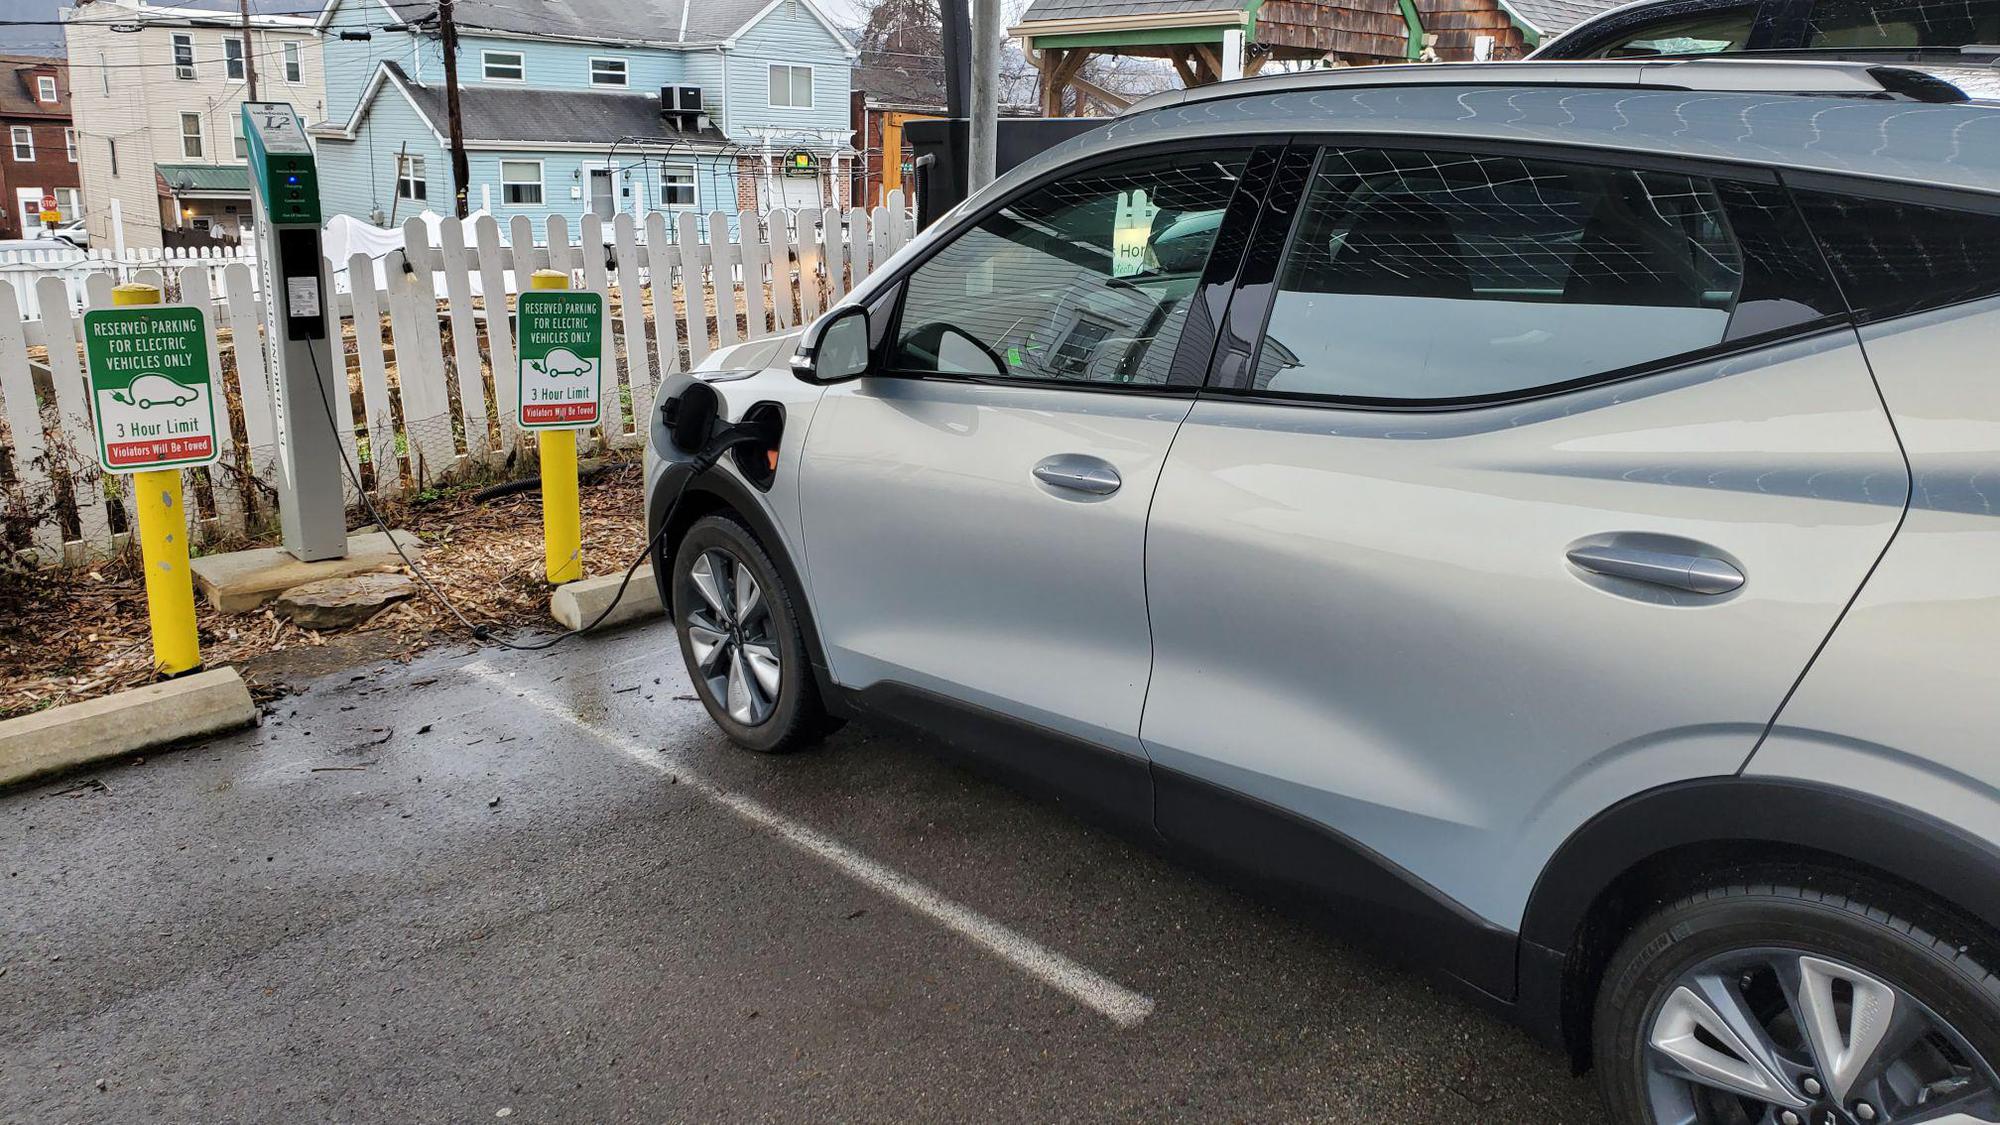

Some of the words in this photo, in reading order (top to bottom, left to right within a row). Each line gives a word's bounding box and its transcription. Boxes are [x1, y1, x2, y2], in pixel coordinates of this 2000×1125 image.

[525, 302, 563, 315] RESERVED
[565, 302, 597, 315] PARKING
[93, 321, 148, 336] RESERVED
[151, 319, 197, 334] PARKING
[534, 317, 550, 329] FOR
[552, 317, 588, 329] ELECTRIC
[109, 339, 132, 353] FOR
[135, 336, 186, 352] ELECTRIC
[530, 332, 569, 344] VEHICLES
[570, 331, 592, 343] ONLY
[106, 355, 160, 371] VEHICLES
[164, 353, 192, 368] ONLY
[531, 388, 537, 401] 3
[541, 387, 564, 400] Hour
[567, 385, 589, 400] Limit
[116, 423, 125, 438] 3
[130, 422, 161, 437] Hour
[166, 417, 199, 434] Limit
[112, 445, 150, 458] Violators
[152, 443, 168, 455] Will
[171, 442, 182, 453] Be
[183, 439, 208, 451] Towed
